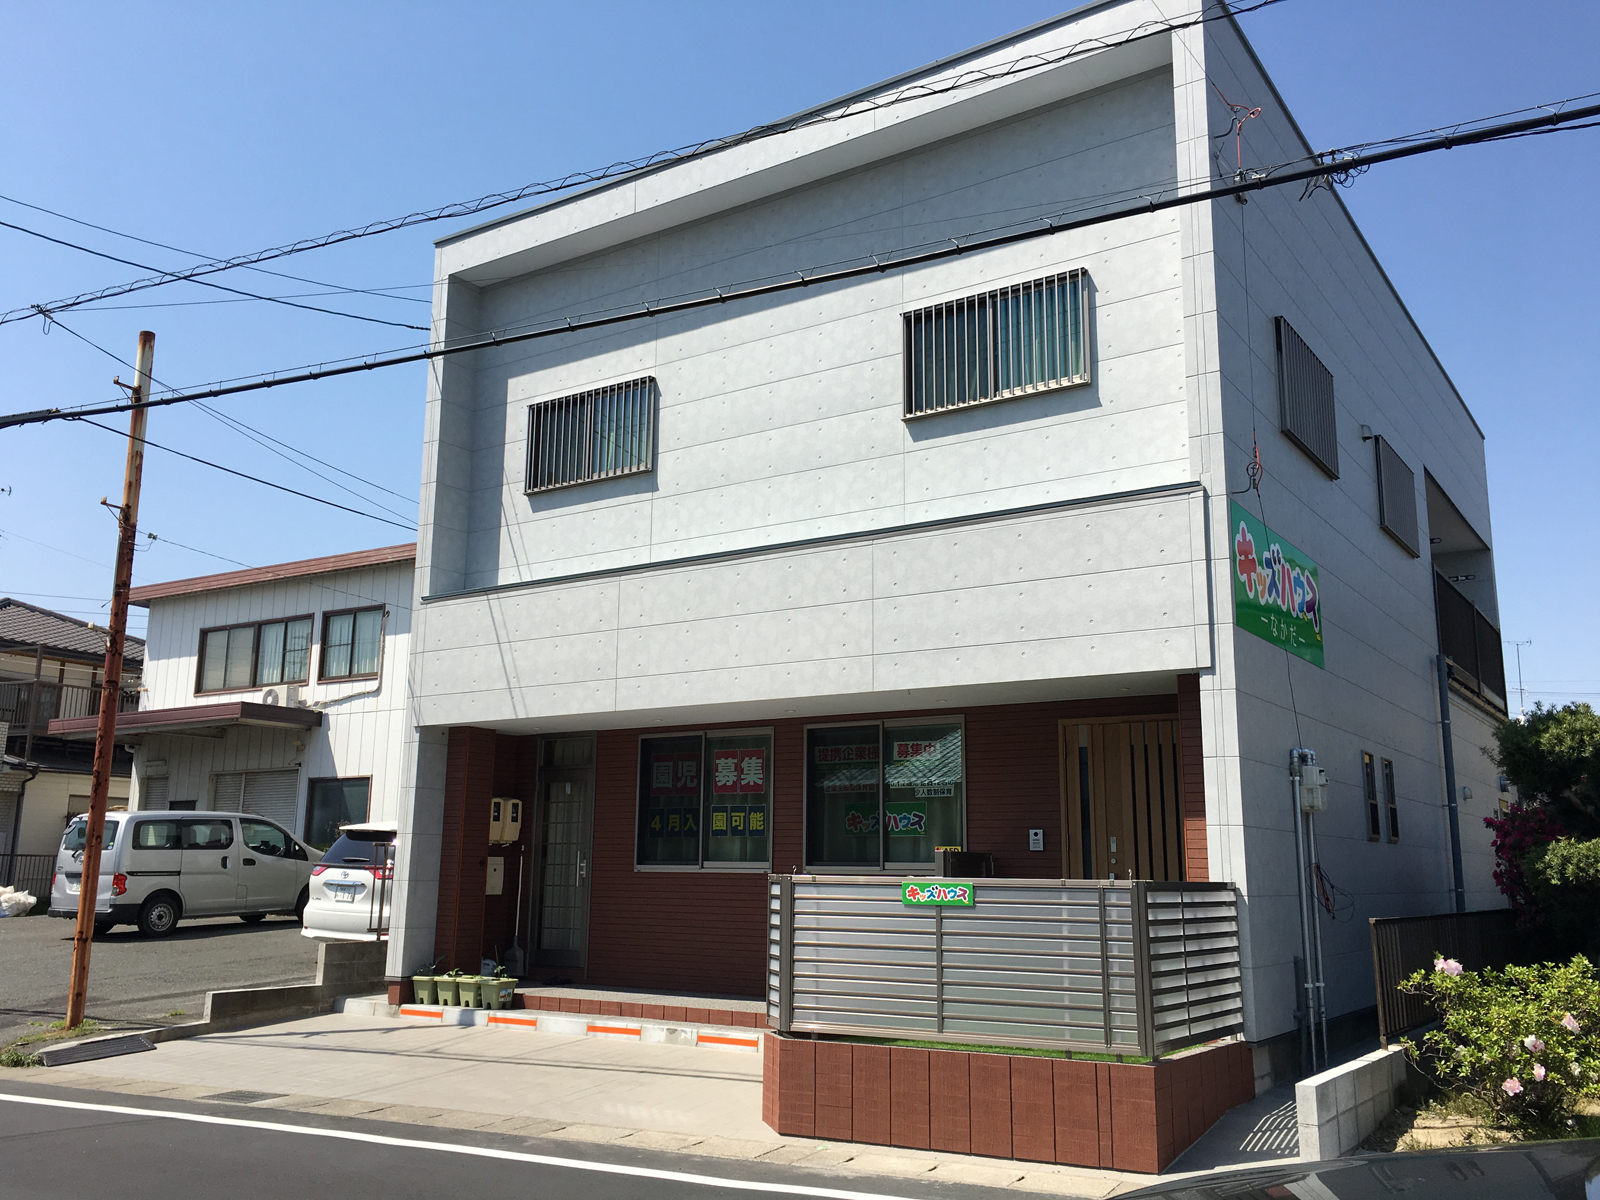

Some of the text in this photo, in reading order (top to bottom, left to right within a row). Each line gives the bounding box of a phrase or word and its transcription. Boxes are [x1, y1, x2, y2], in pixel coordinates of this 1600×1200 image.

[1236, 521, 1319, 632] キッズハウス
[906, 885, 969, 902] キッズハウス
